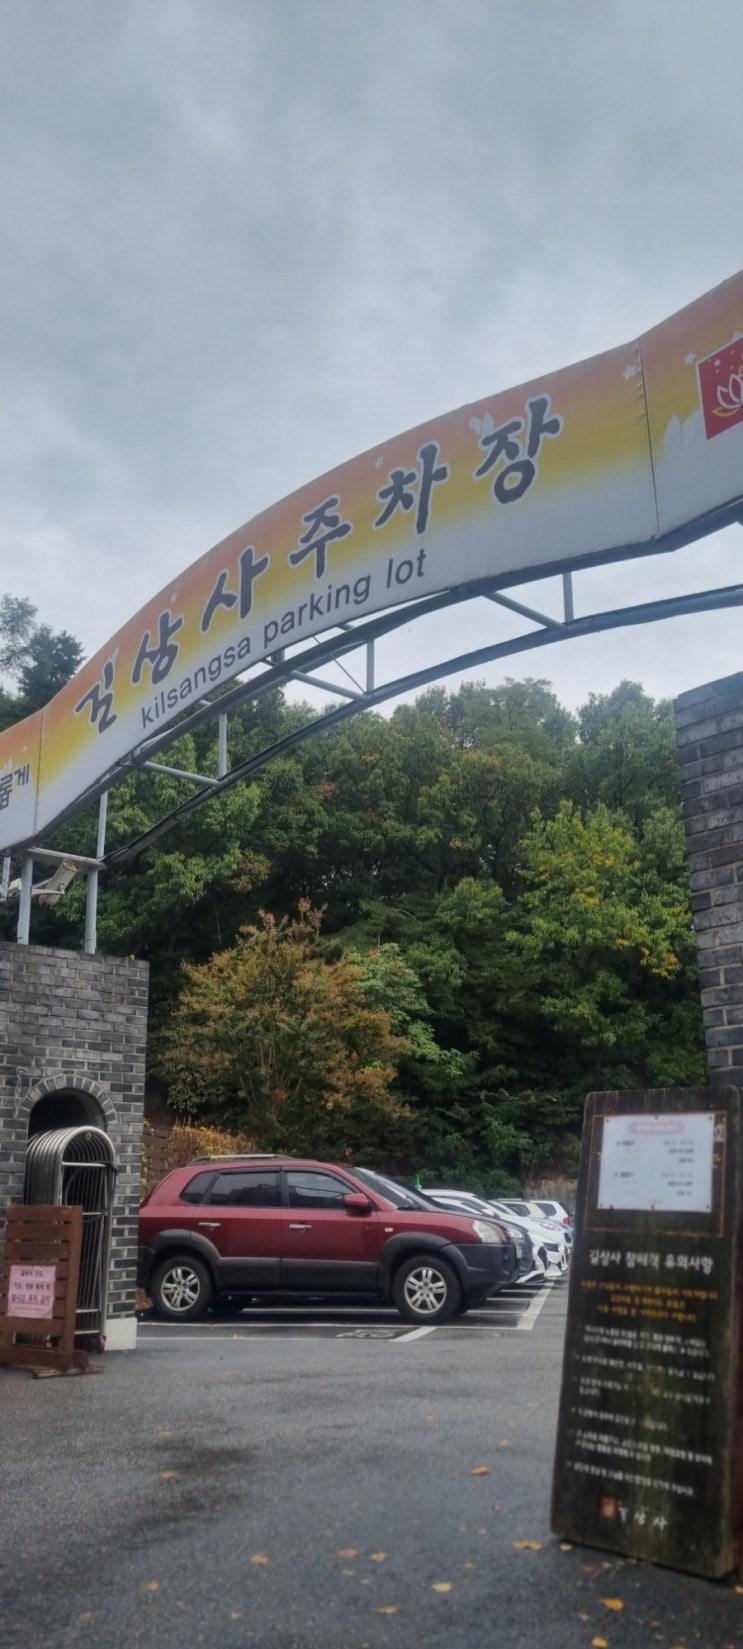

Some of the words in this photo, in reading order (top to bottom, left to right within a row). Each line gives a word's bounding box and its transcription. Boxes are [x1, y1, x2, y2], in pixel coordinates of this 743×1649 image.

[141, 636, 251, 729] kilsangsa
[263, 574, 372, 648] parking
[386, 549, 426, 588] lot
[589, 1248, 621, 1267] 길상사
[625, 1251, 660, 1271] 참배객
[665, 1254, 714, 1274] 유의사항
